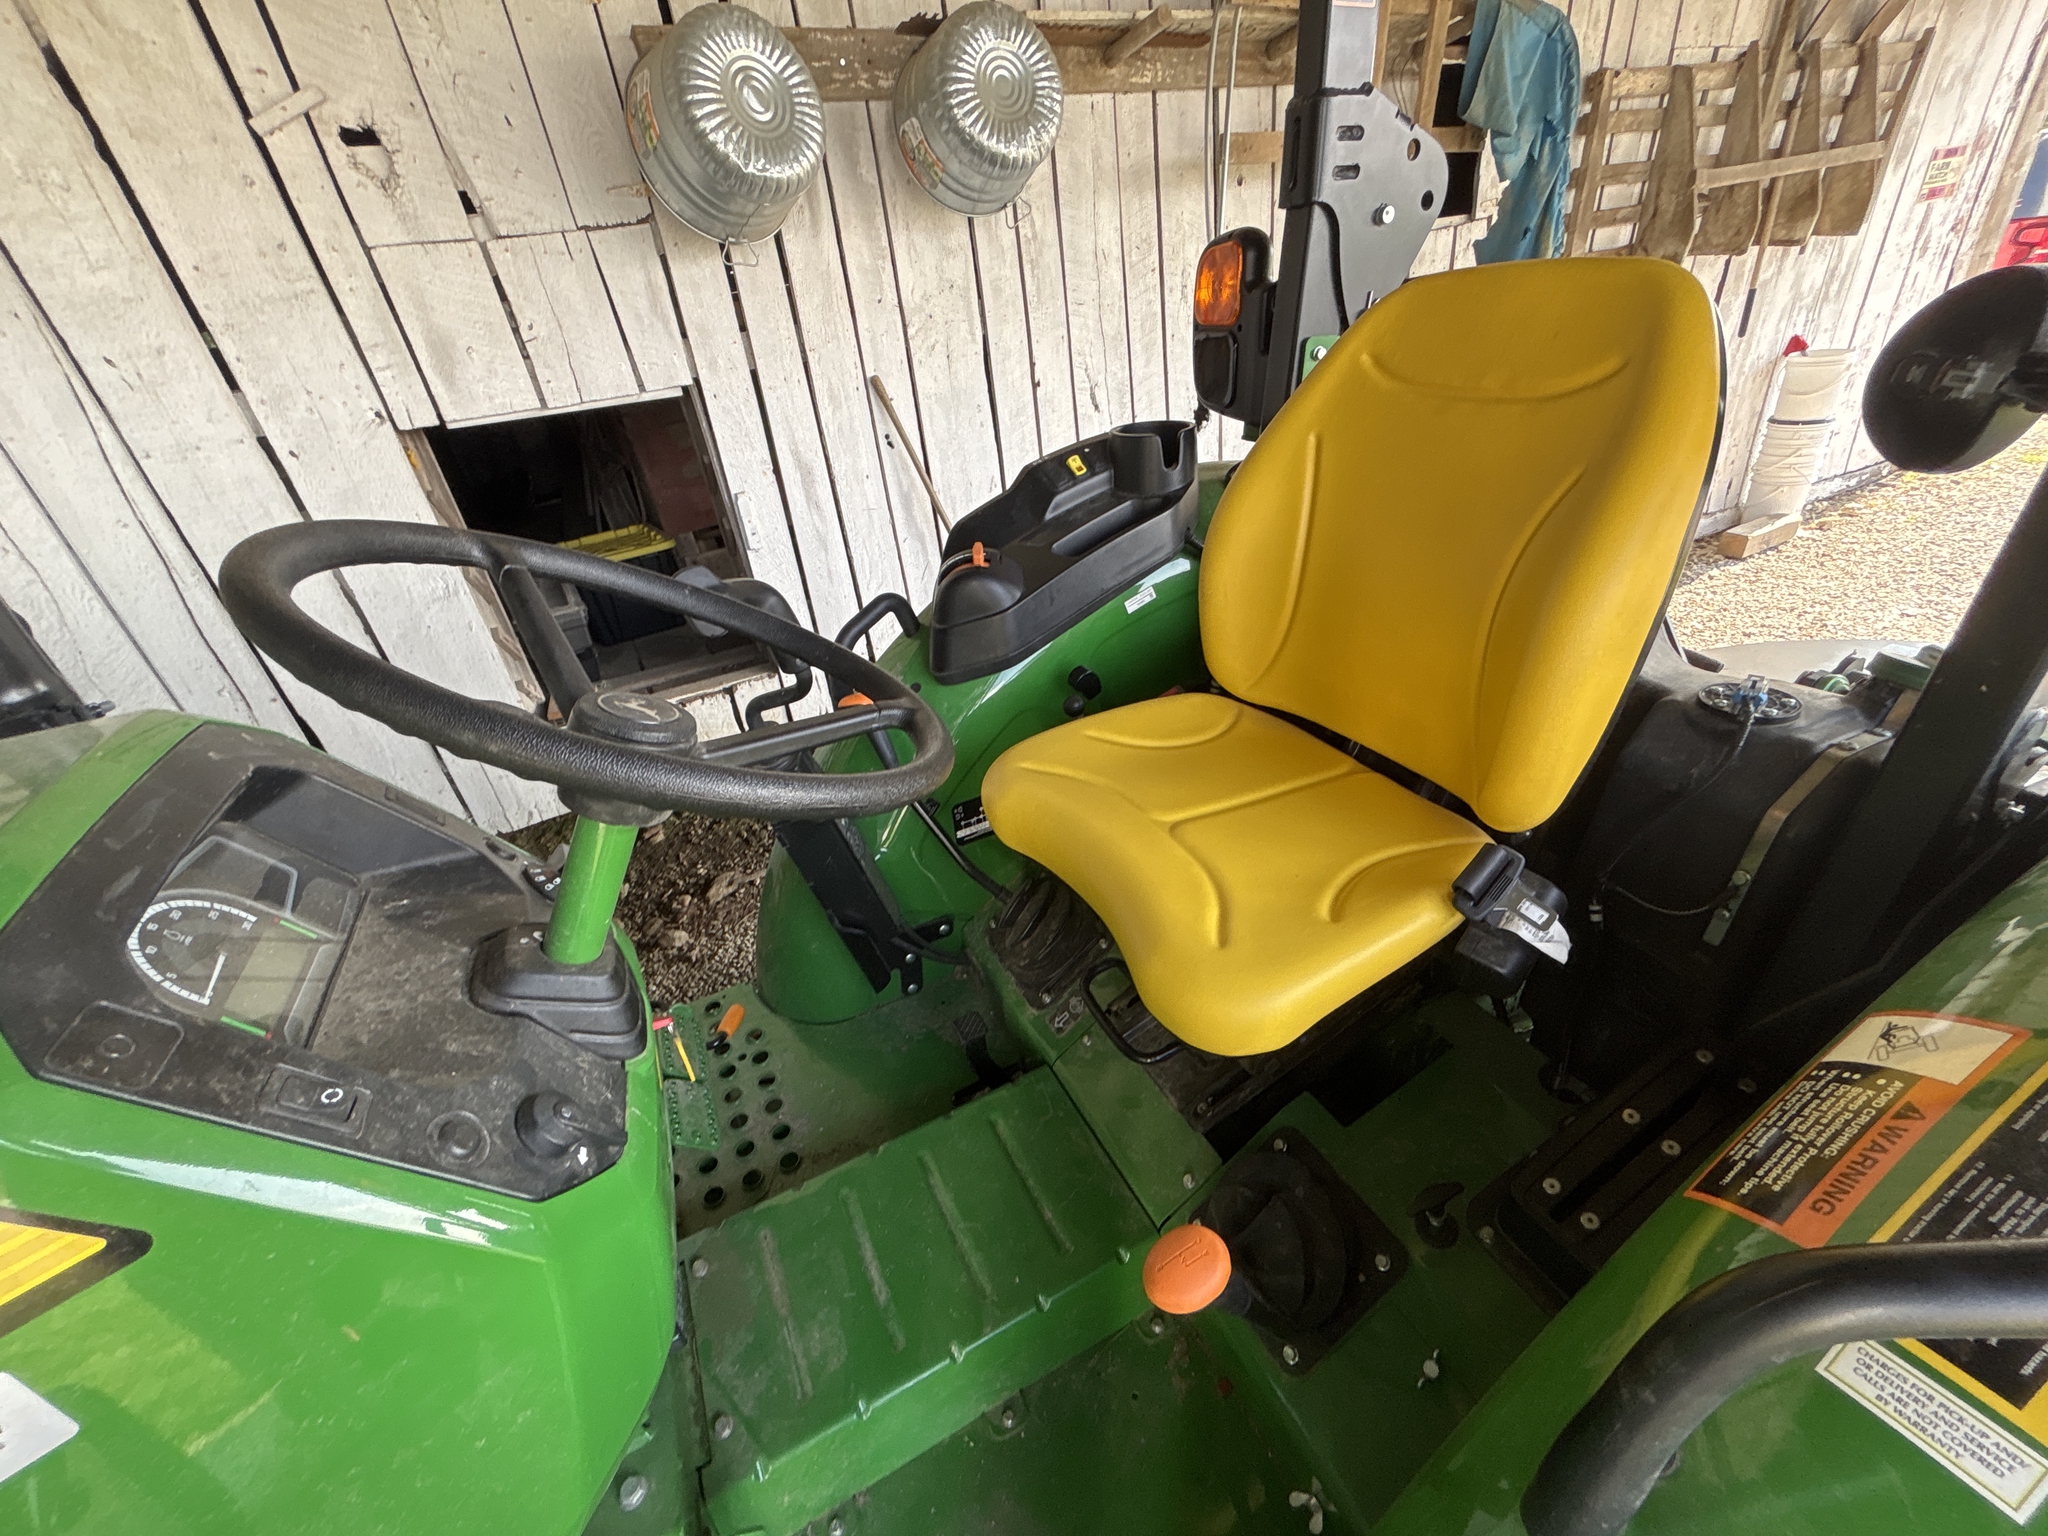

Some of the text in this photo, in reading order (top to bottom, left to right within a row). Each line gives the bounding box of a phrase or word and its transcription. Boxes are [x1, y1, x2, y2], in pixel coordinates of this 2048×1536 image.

[166, 972, 177, 980] 5
[1812, 1069, 1840, 1090] When
[1834, 1084, 1851, 1096] Do
[1776, 1092, 1814, 1126] structure
[1782, 1083, 1840, 1134] Use seat belt.
[1793, 1110, 1823, 1132] jump
[1818, 1097, 1836, 1111] not
[1821, 1080, 1904, 1158] AVOID CRUSHING:
[1755, 1127, 1778, 1147] must
[1761, 1086, 1863, 1184] Structure fully extended.
[1771, 1089, 1876, 1191] Keep Rollover Protective
[1745, 1148, 1759, 1159] be
[1756, 1140, 1792, 1176] machine
[1809, 1125, 1908, 1215] WARNING
[1737, 1177, 1759, 1195] tips.
[1853, 1367, 2005, 1478] CALLS ARE NOT COVERED
[1856, 1358, 2016, 1474] OR DELIVERY AND SERVICE
[1857, 1346, 2031, 1468] CHARGES FOR PICK-UP AND/
[1875, 1394, 1963, 1459] BY WARRANTY
